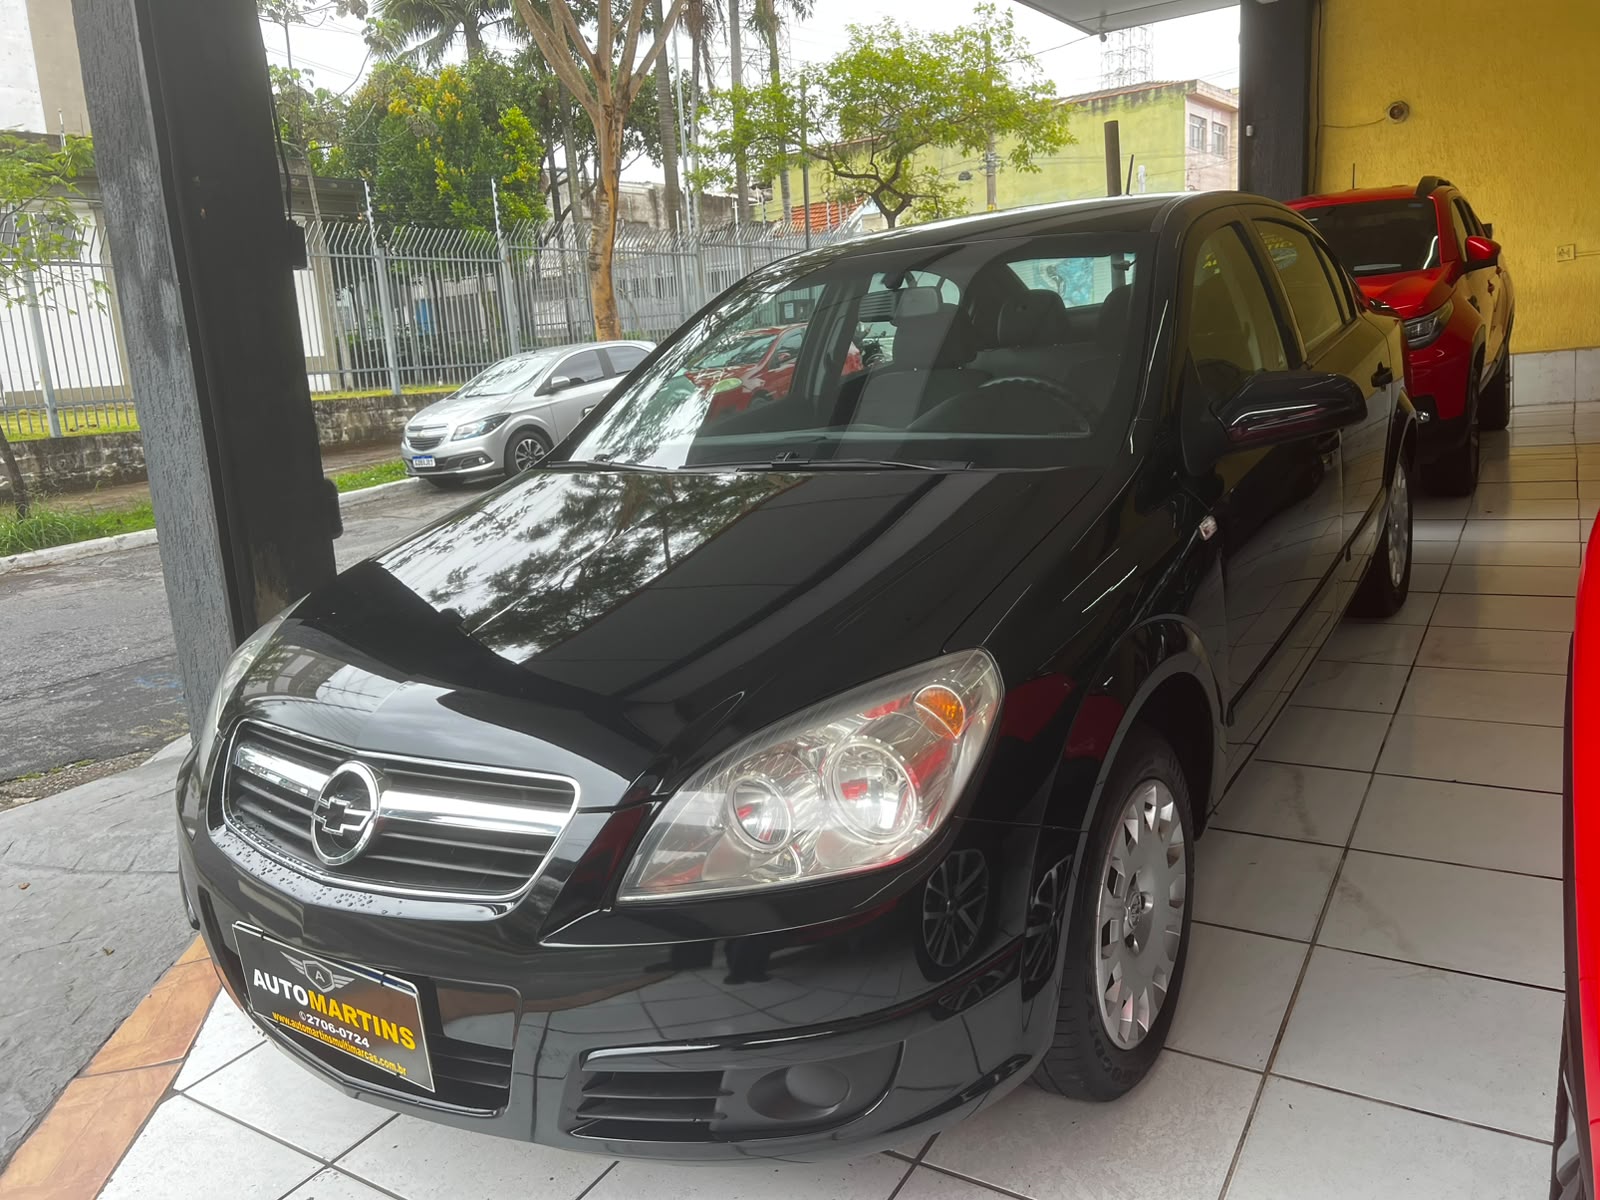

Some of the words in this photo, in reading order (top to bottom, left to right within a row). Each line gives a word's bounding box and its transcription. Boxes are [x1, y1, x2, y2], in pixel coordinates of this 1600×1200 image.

[253, 968, 417, 1050] AUTOMARTINS
[306, 1014, 370, 1048] 2706-0724
[272, 1011, 408, 1076] www.automartinsmultimarcas.com.br
